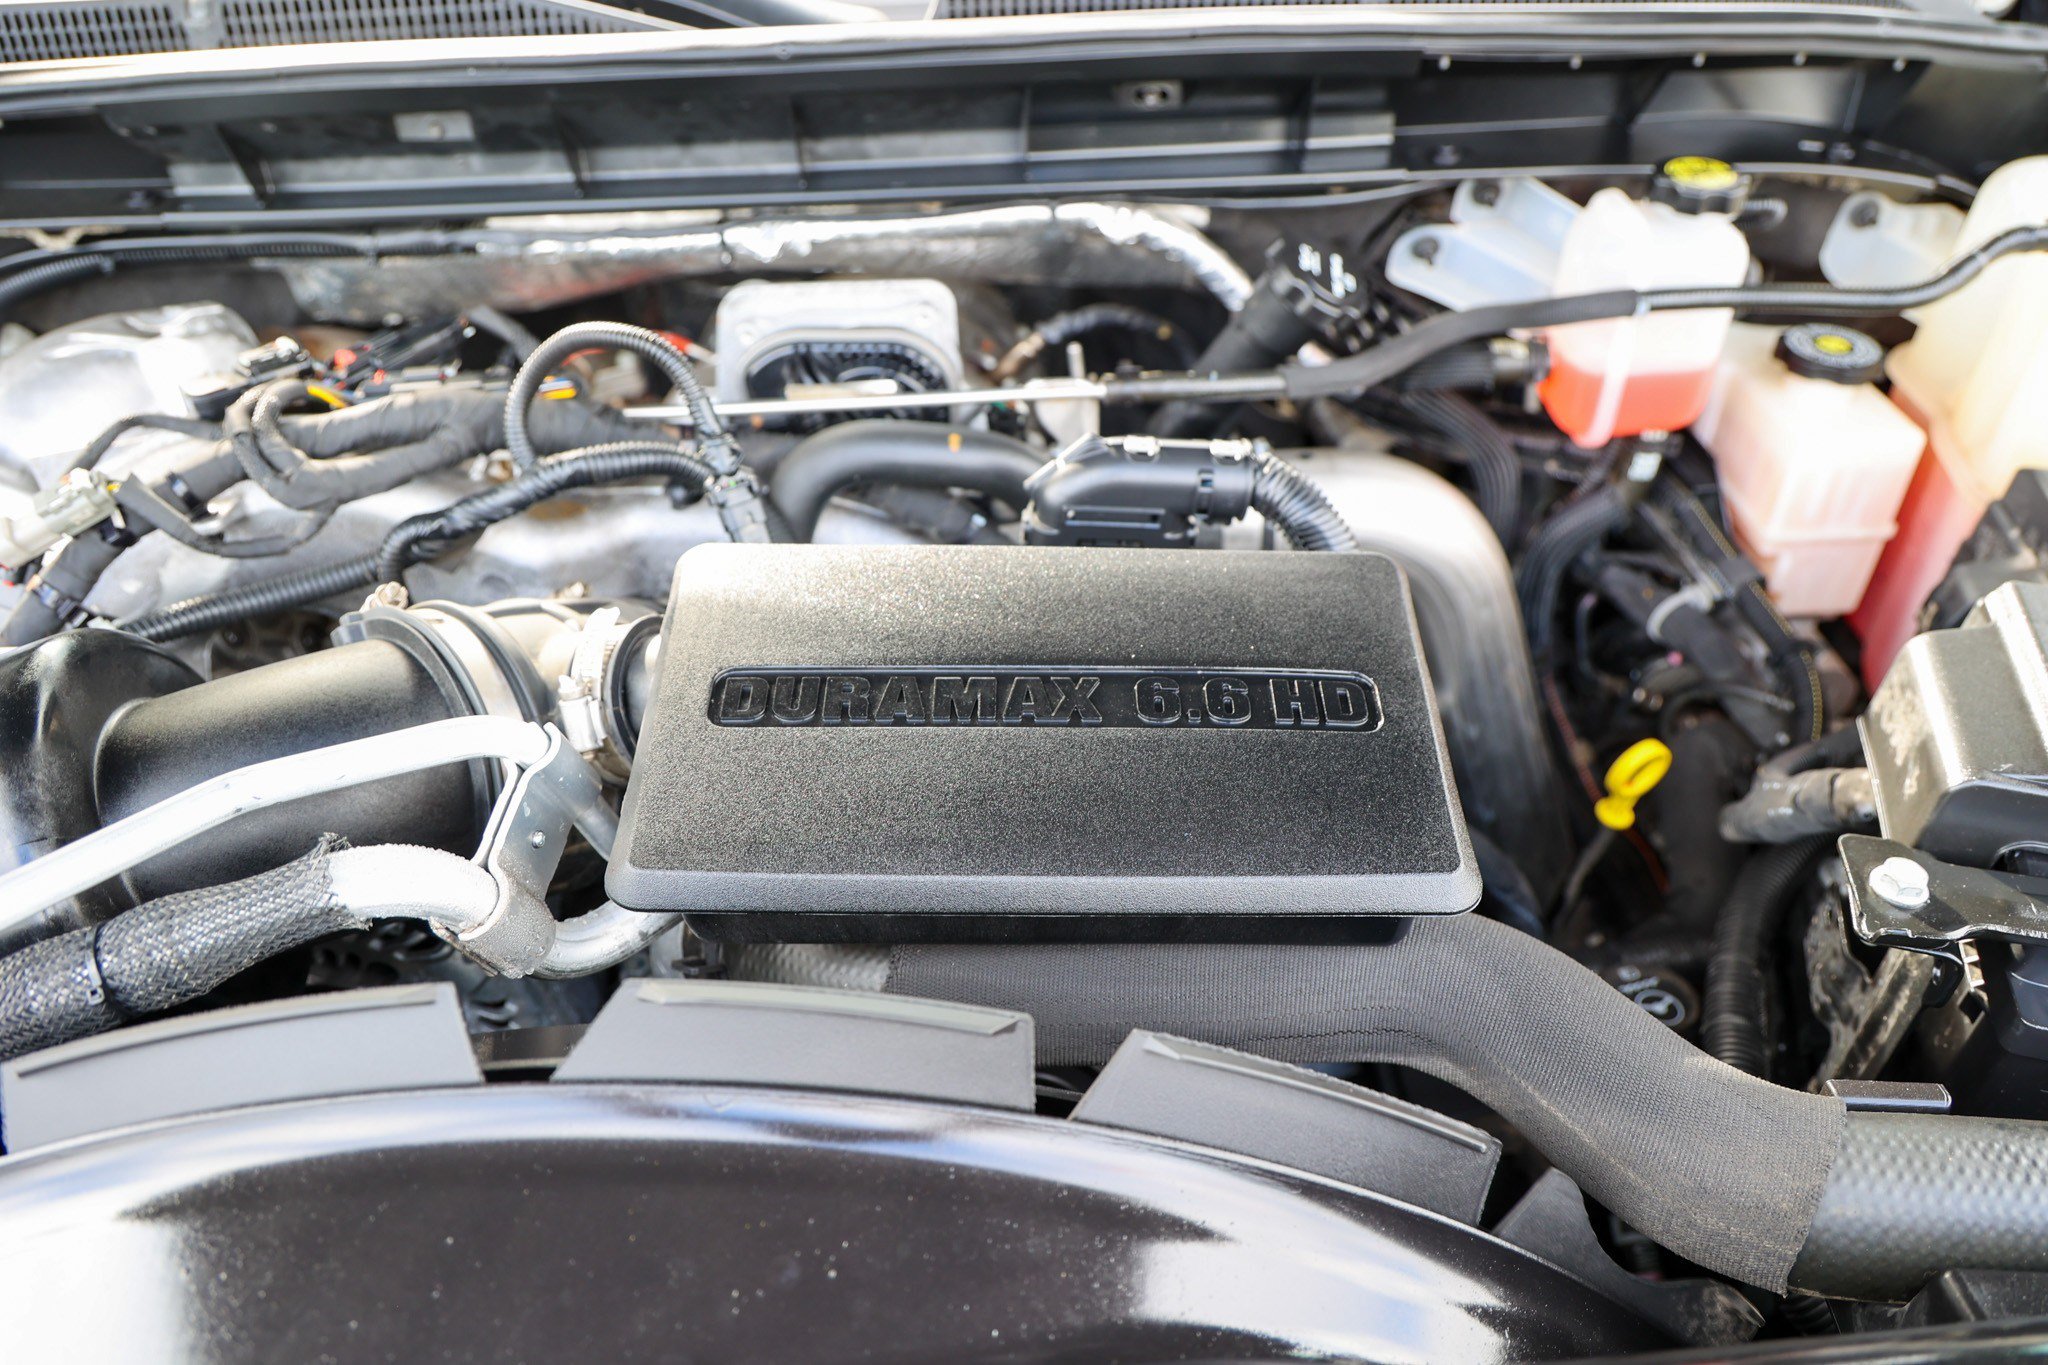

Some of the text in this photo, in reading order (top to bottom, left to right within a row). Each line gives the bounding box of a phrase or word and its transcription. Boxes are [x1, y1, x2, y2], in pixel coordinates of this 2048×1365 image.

[719, 676, 1369, 725] DURAMAX 6.6 HD
